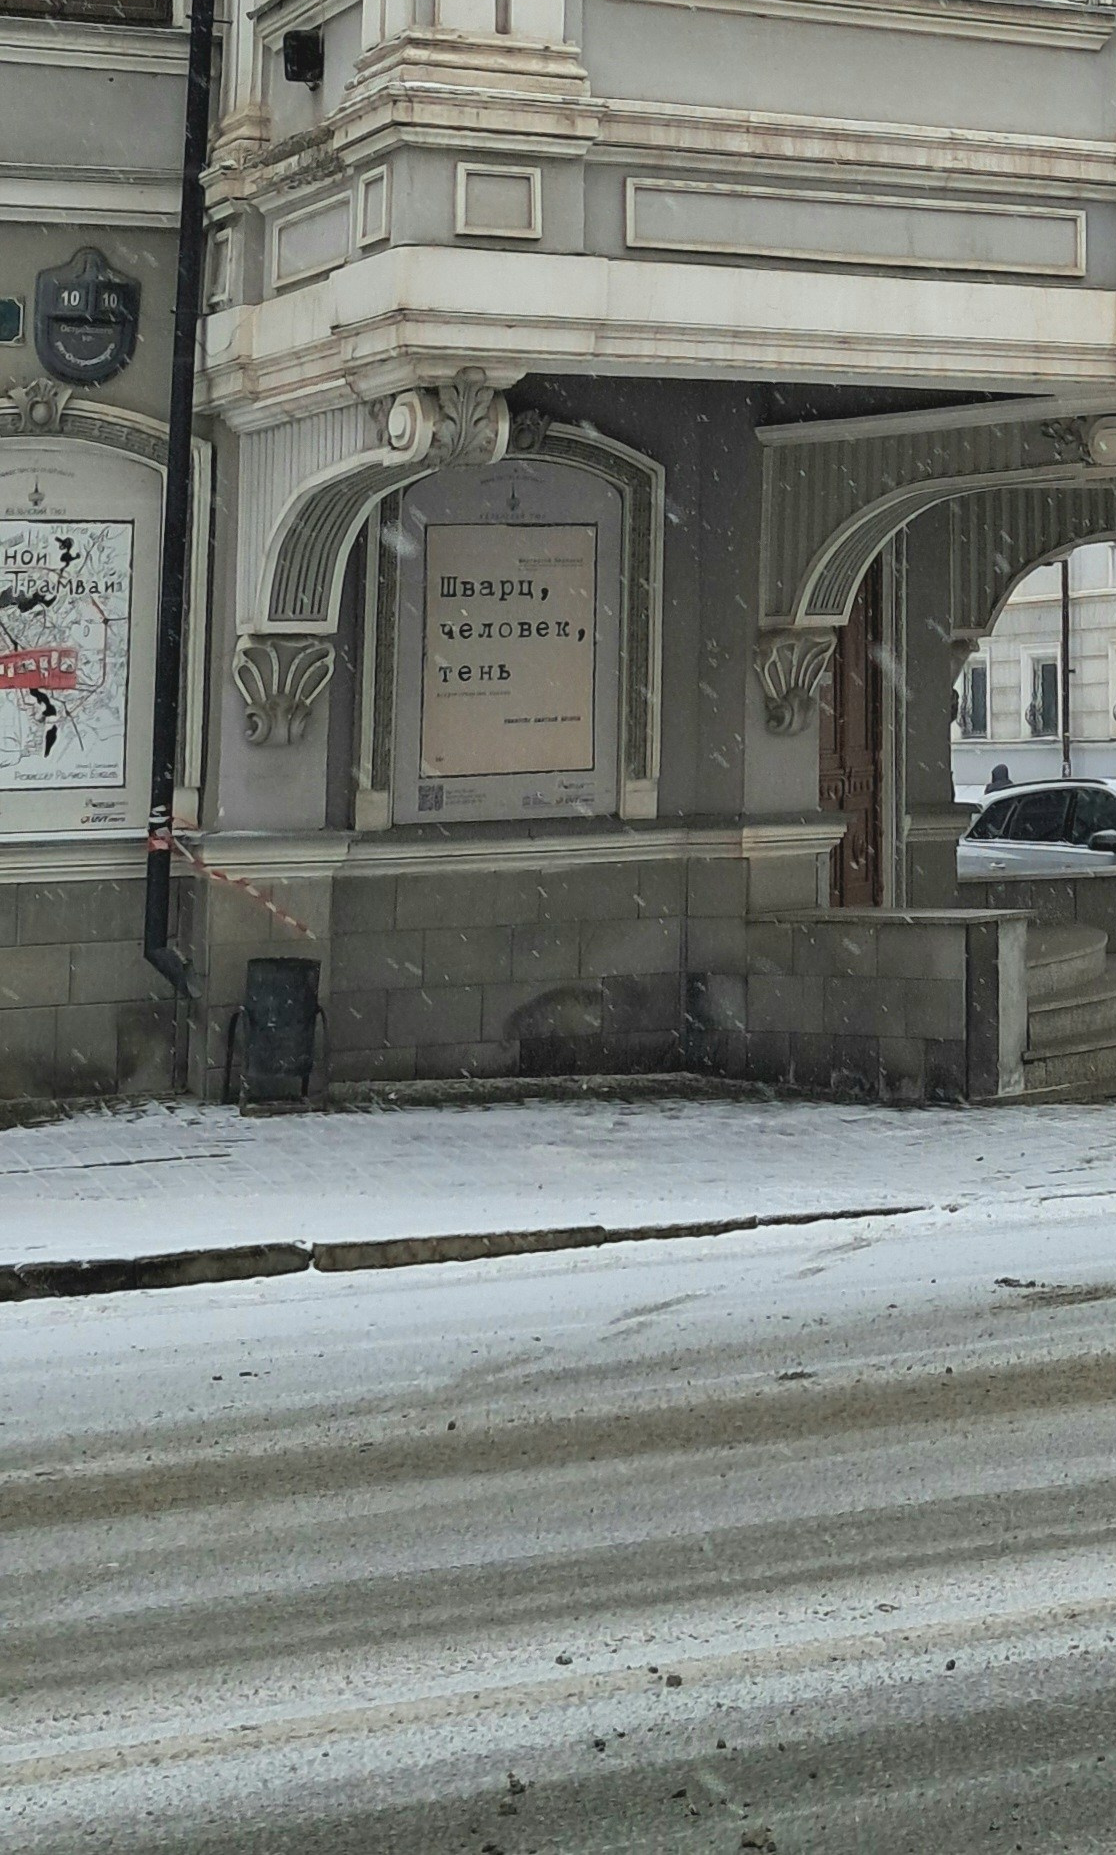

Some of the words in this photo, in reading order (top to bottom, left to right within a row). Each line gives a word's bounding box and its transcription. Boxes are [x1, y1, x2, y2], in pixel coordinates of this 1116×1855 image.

[61, 290, 80, 306] 10
[102, 292, 118, 308] 10
[440, 576, 549, 601] Шварц,
[440, 620, 586, 642] человек,
[438, 664, 511, 683] тень
